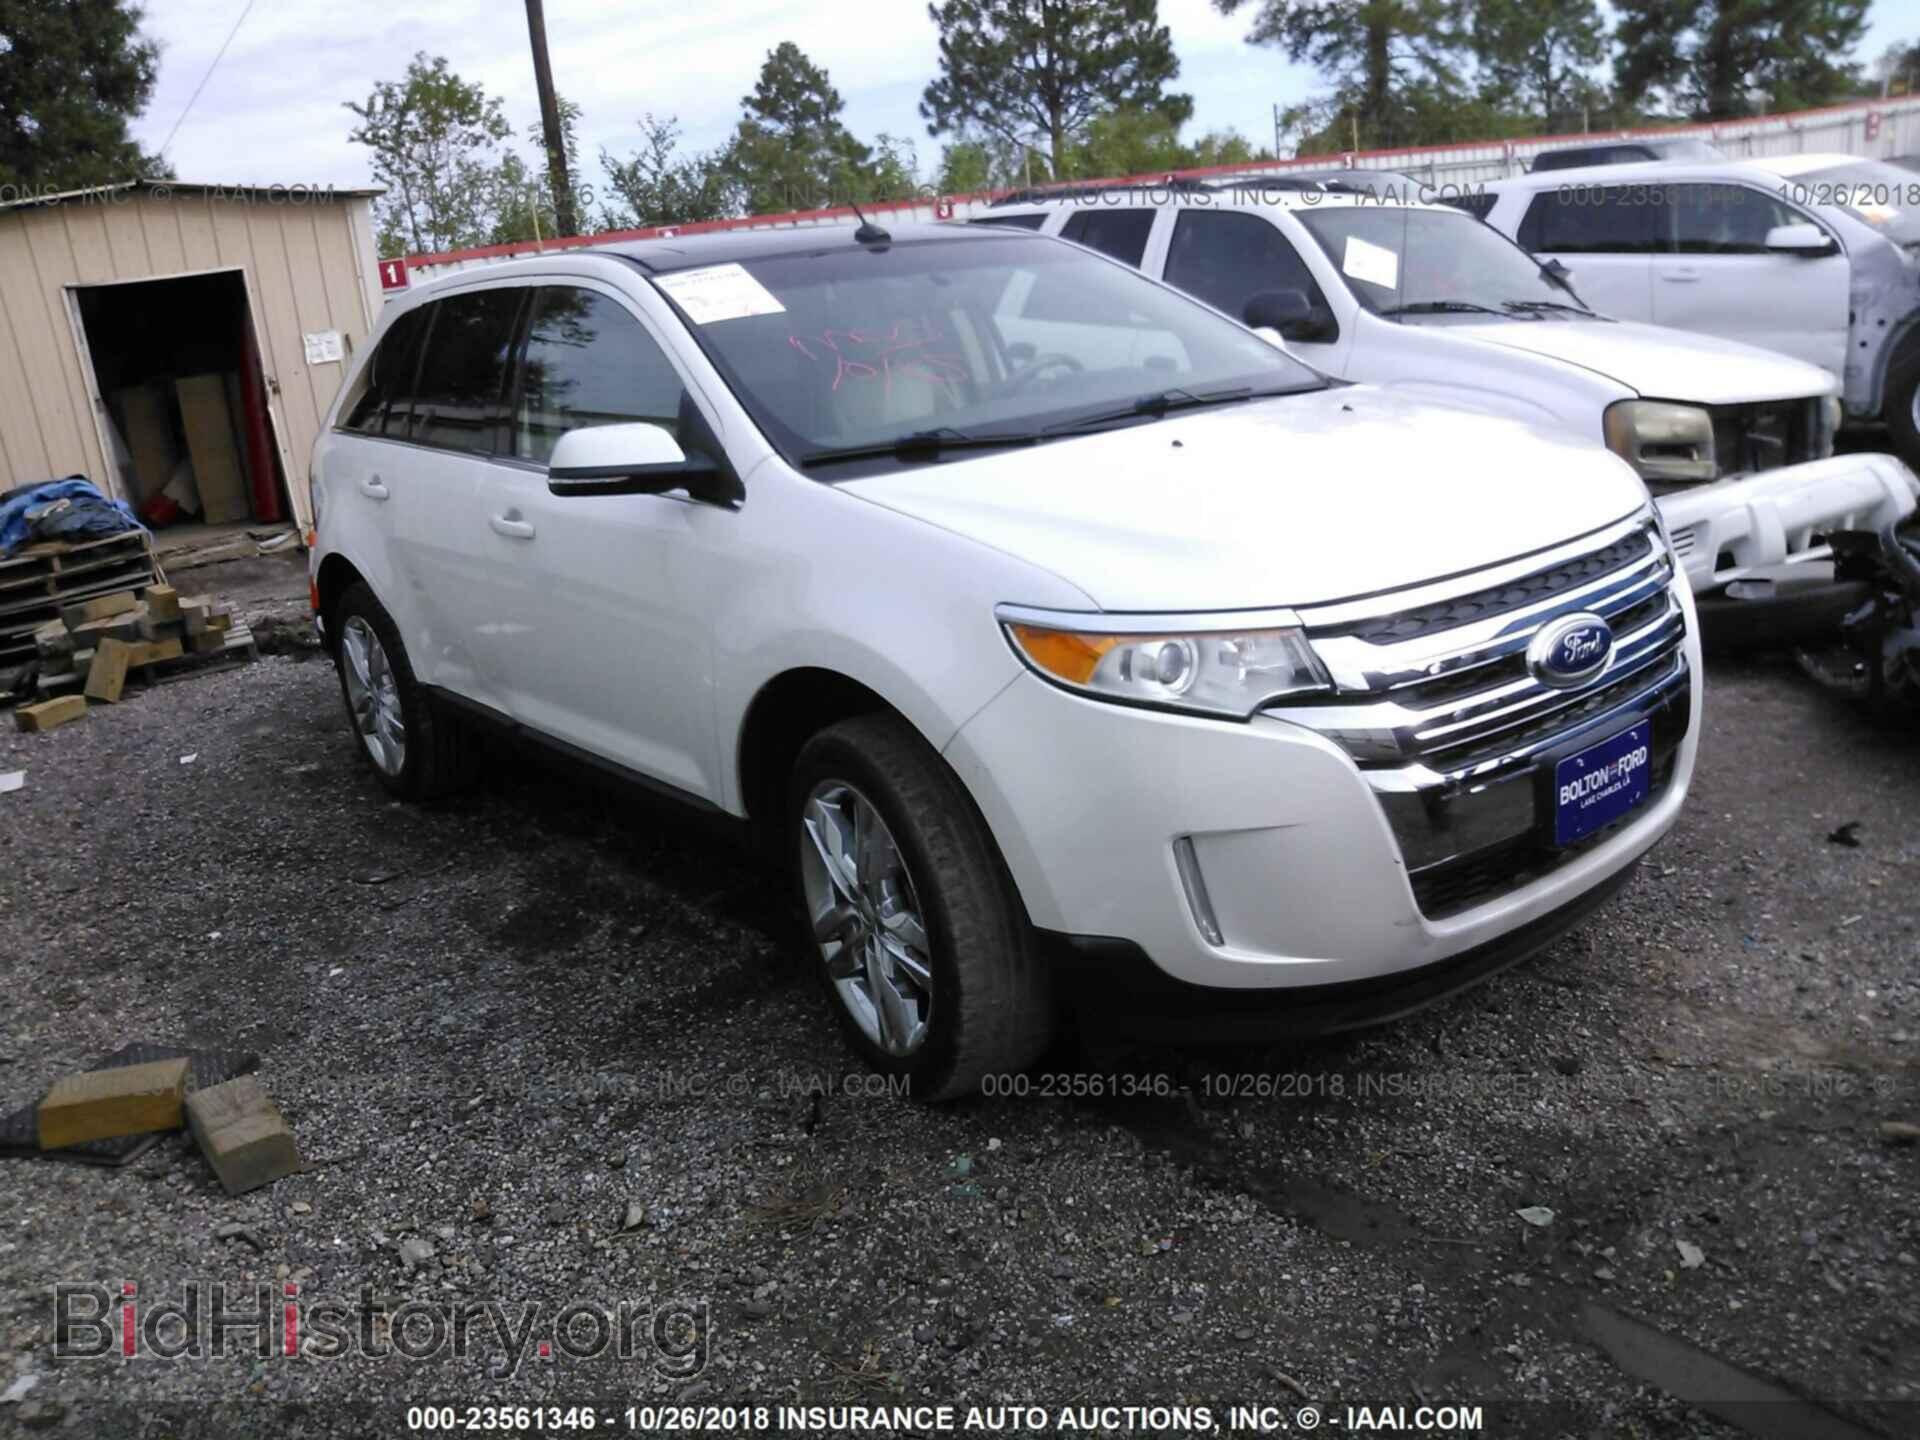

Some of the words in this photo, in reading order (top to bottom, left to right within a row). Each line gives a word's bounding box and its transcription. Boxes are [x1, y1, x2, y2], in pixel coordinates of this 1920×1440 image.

[387, 263, 397, 283] 1
[1564, 629, 1603, 662] Ford
[1560, 765, 1609, 806] BOLTON
[1618, 746, 1647, 776] FORD
